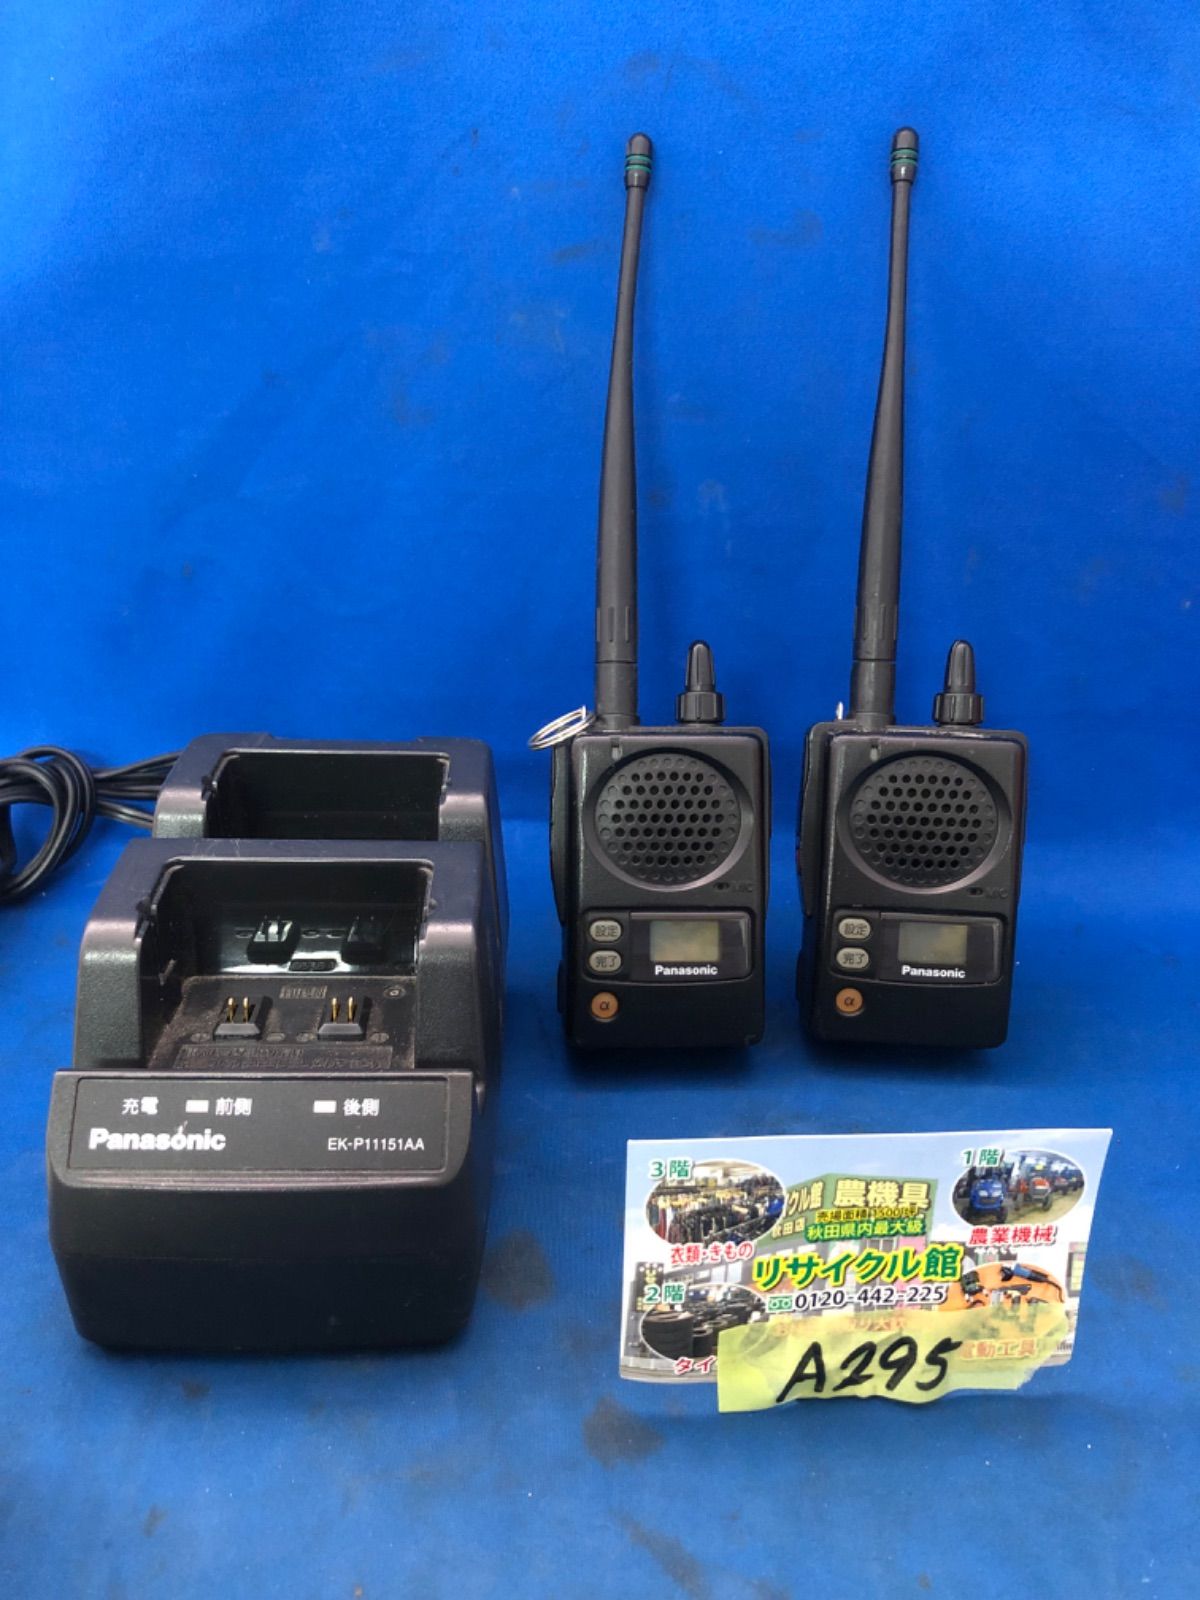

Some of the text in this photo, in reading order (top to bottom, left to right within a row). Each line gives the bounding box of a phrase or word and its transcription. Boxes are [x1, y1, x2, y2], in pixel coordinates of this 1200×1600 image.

[654, 964, 718, 976] Panasonic
[901, 964, 966, 979] Panasonic
[121, 1096, 381, 1117] 充電 前側 後側
[88, 1126, 227, 1152] Panasonic
[327, 1136, 425, 1152] EK-P11151AA
[962, 1148, 1001, 1166] 1階
[650, 1159, 690, 1178] 3階
[834, 1178, 930, 1209] 農機具
[806, 1218, 923, 1240] 秋田県内最大級
[968, 1224, 1055, 1246] 農業機械
[754, 1244, 961, 1291] リサイクル館
[645, 1284, 685, 1302] 2階
[794, 1285, 946, 1310] 0120-442-225
[776, 1335, 963, 1403] A295
